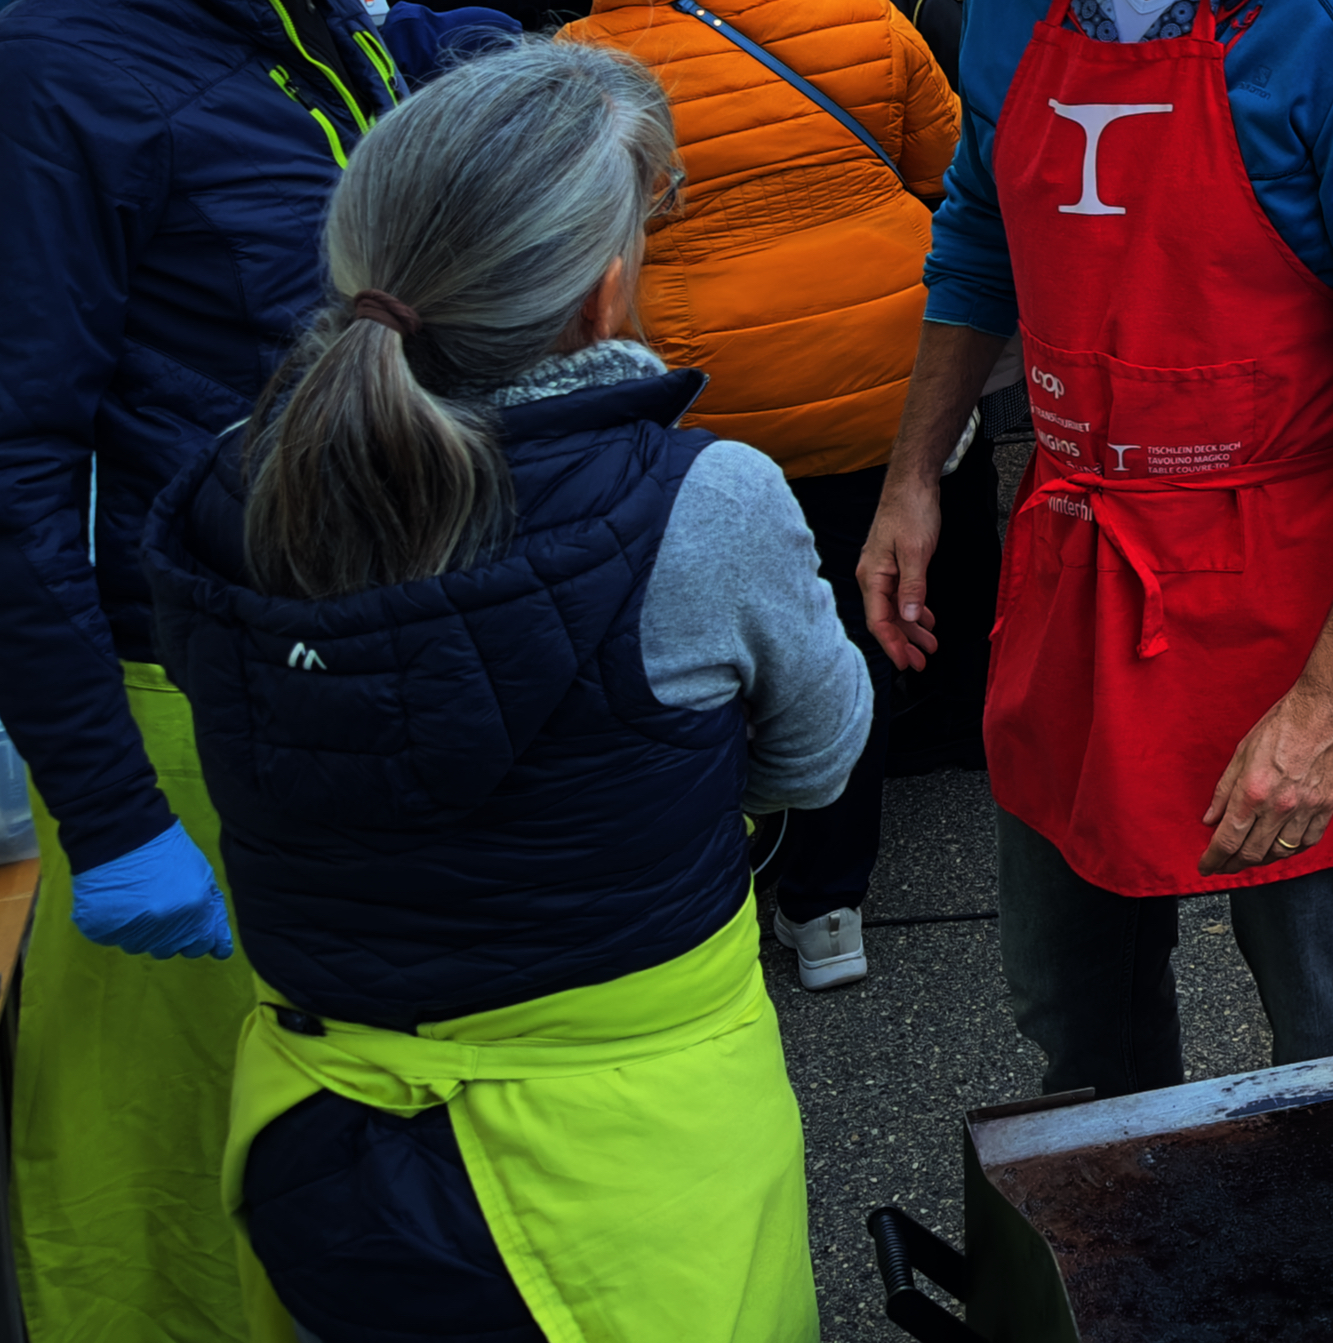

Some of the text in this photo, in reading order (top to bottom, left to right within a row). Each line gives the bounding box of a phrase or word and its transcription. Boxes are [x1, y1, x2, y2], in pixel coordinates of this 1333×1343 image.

[1148, 441, 1241, 454] TISCHLEIN DECK DICH
[1148, 453, 1230, 465] TAVOLINO MAGICO
[1148, 465, 1174, 474] TABLE
